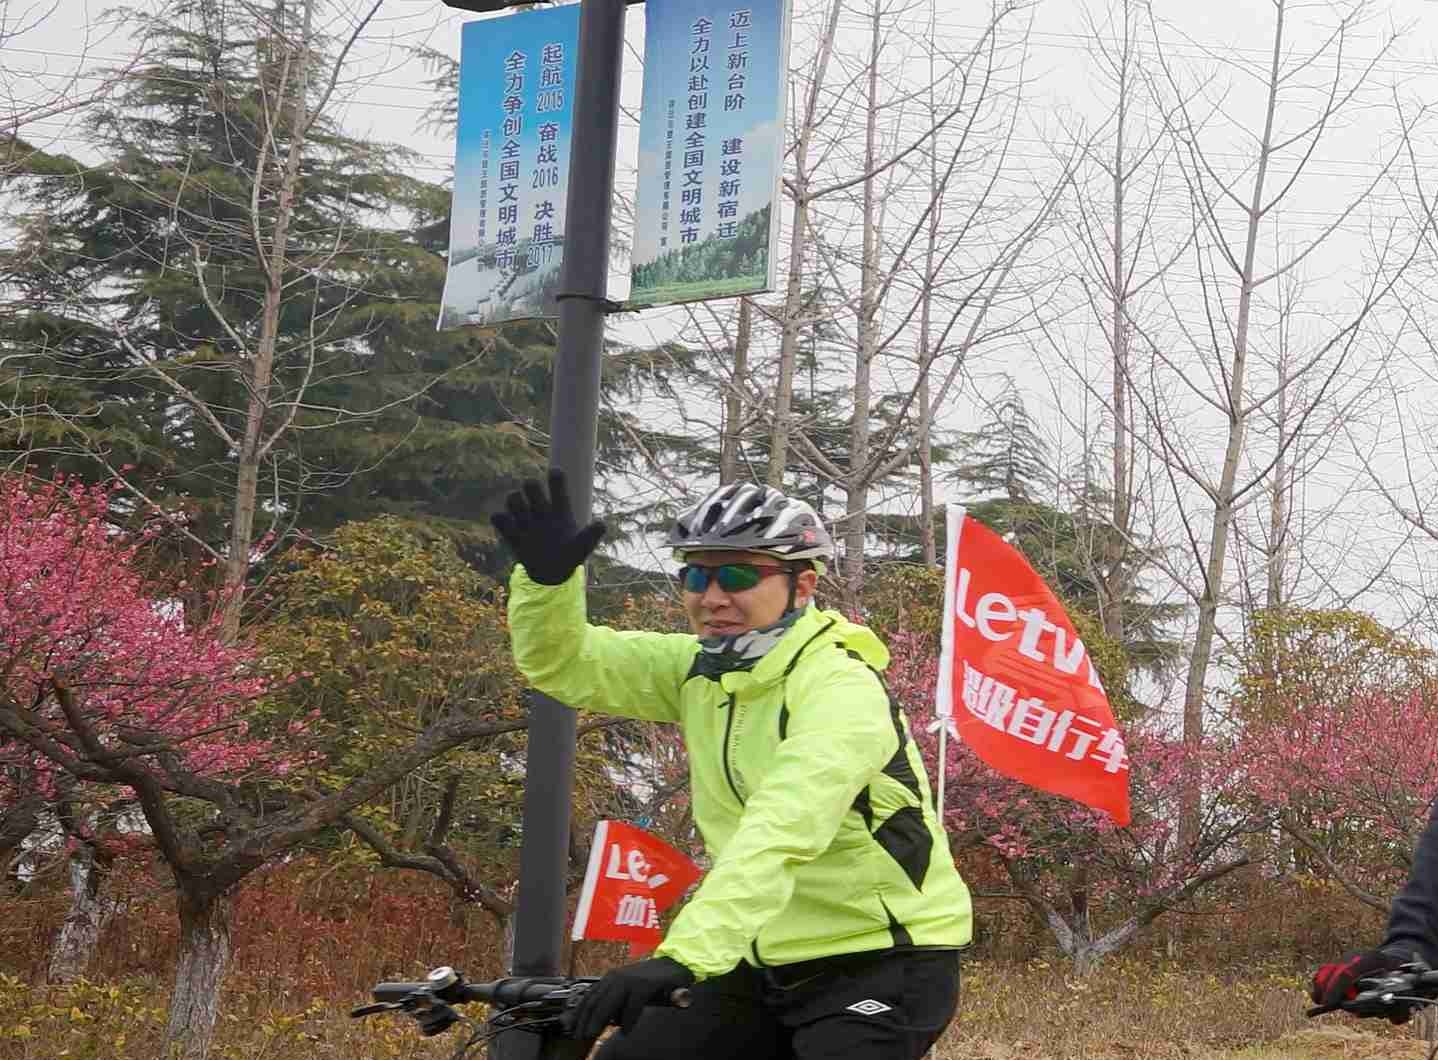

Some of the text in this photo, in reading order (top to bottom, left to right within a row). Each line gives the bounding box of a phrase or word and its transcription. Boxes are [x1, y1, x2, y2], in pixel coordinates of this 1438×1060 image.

[496, 51, 527, 268] 全力争创全国文明城市
[679, 18, 712, 244] 全力以赴创建全国文明城市
[717, 10, 751, 241] 迈上新台阶 建设新宿迁
[955, 566, 1087, 676] Letv
[605, 842, 671, 889] Le
